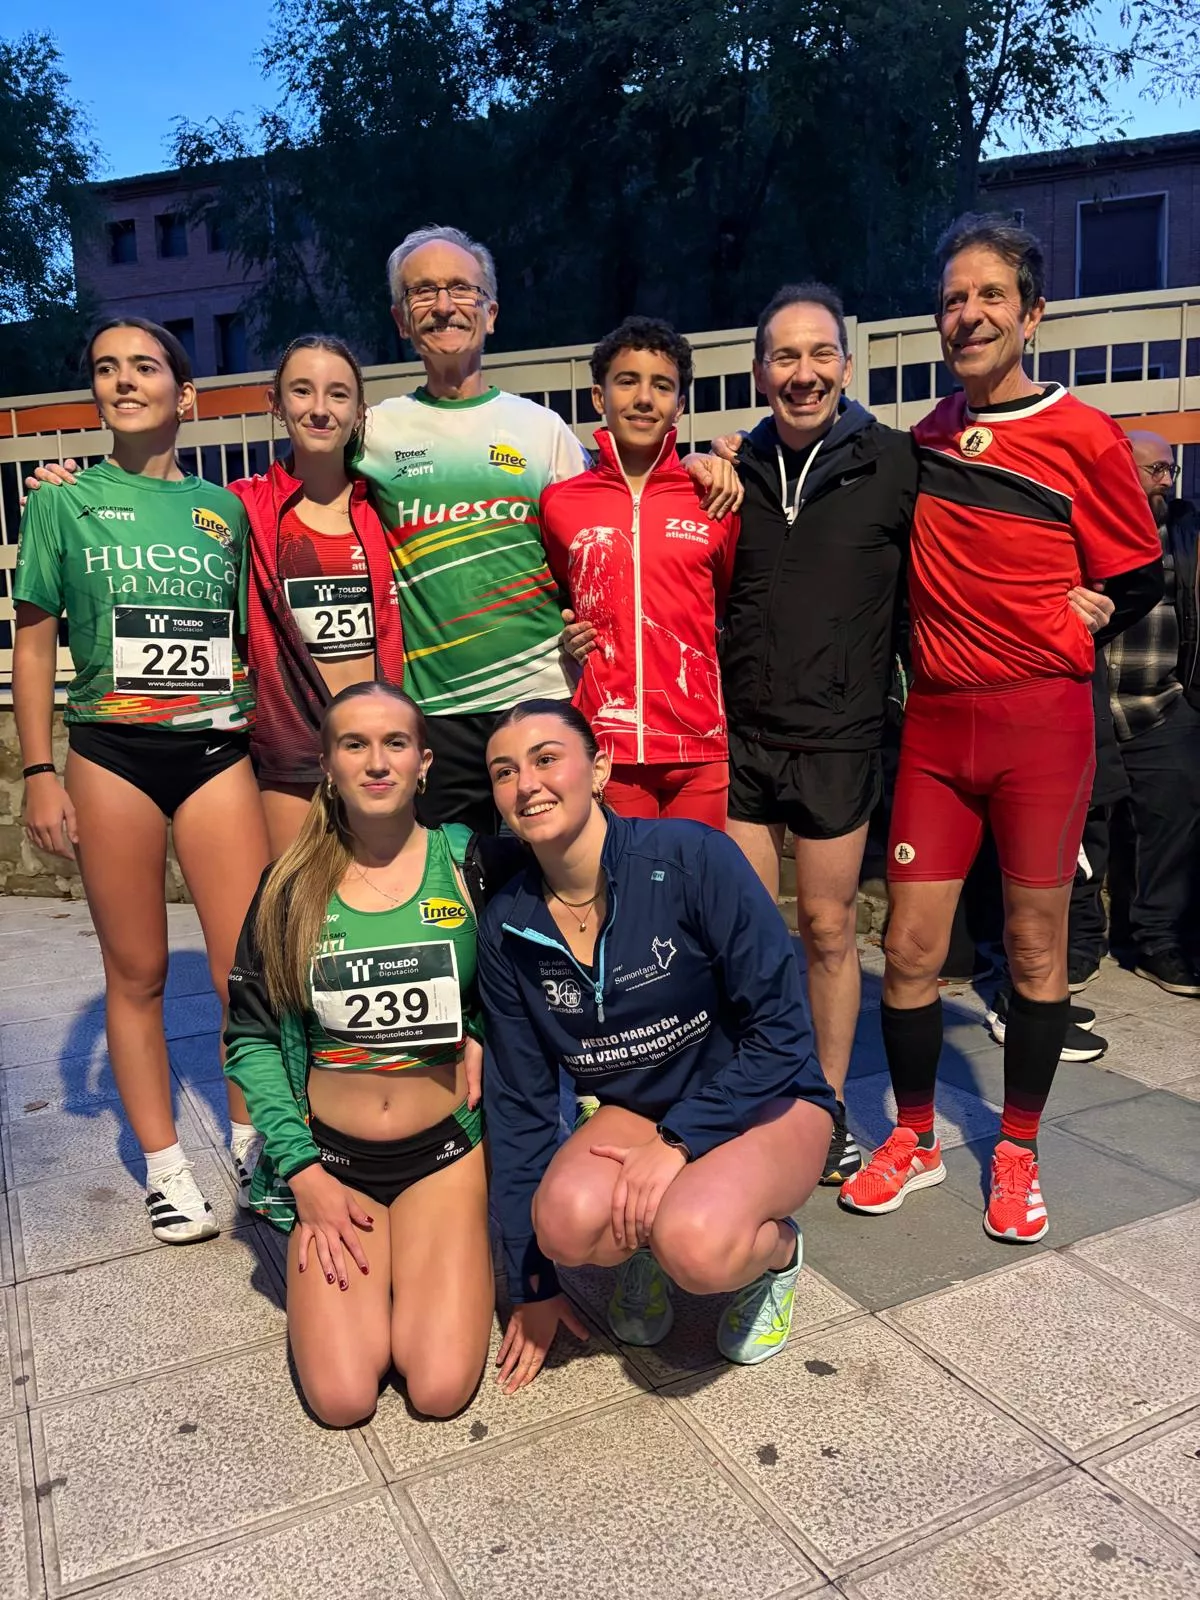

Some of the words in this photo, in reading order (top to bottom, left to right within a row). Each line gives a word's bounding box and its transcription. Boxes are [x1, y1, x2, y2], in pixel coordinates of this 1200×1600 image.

[395, 449, 427, 460] Protex
[489, 445, 527, 468] intec
[408, 464, 433, 477] ZOITI
[97, 511, 136, 521] ZOITI
[192, 507, 231, 537] intec
[398, 498, 530, 528] Huesca
[665, 518, 709, 537] ZGZ
[665, 531, 708, 544] atletismo
[172, 619, 204, 627] TOLEDO
[315, 607, 372, 640] 251
[142, 643, 210, 676] 225
[420, 901, 467, 920] intec
[378, 958, 418, 970] TOLEDO
[379, 967, 419, 977] Diputación
[614, 964, 657, 985] Somontano
[345, 987, 429, 1029] 239
[355, 1029, 423, 1041] www.diputoledo.es
[581, 1035, 619, 1049] MEDIO
[620, 1015, 680, 1042] MARATÓN
[596, 1047, 628, 1062] VINO
[629, 1010, 709, 1056] SOMONTANO
[321, 1152, 350, 1166] ZOITI
